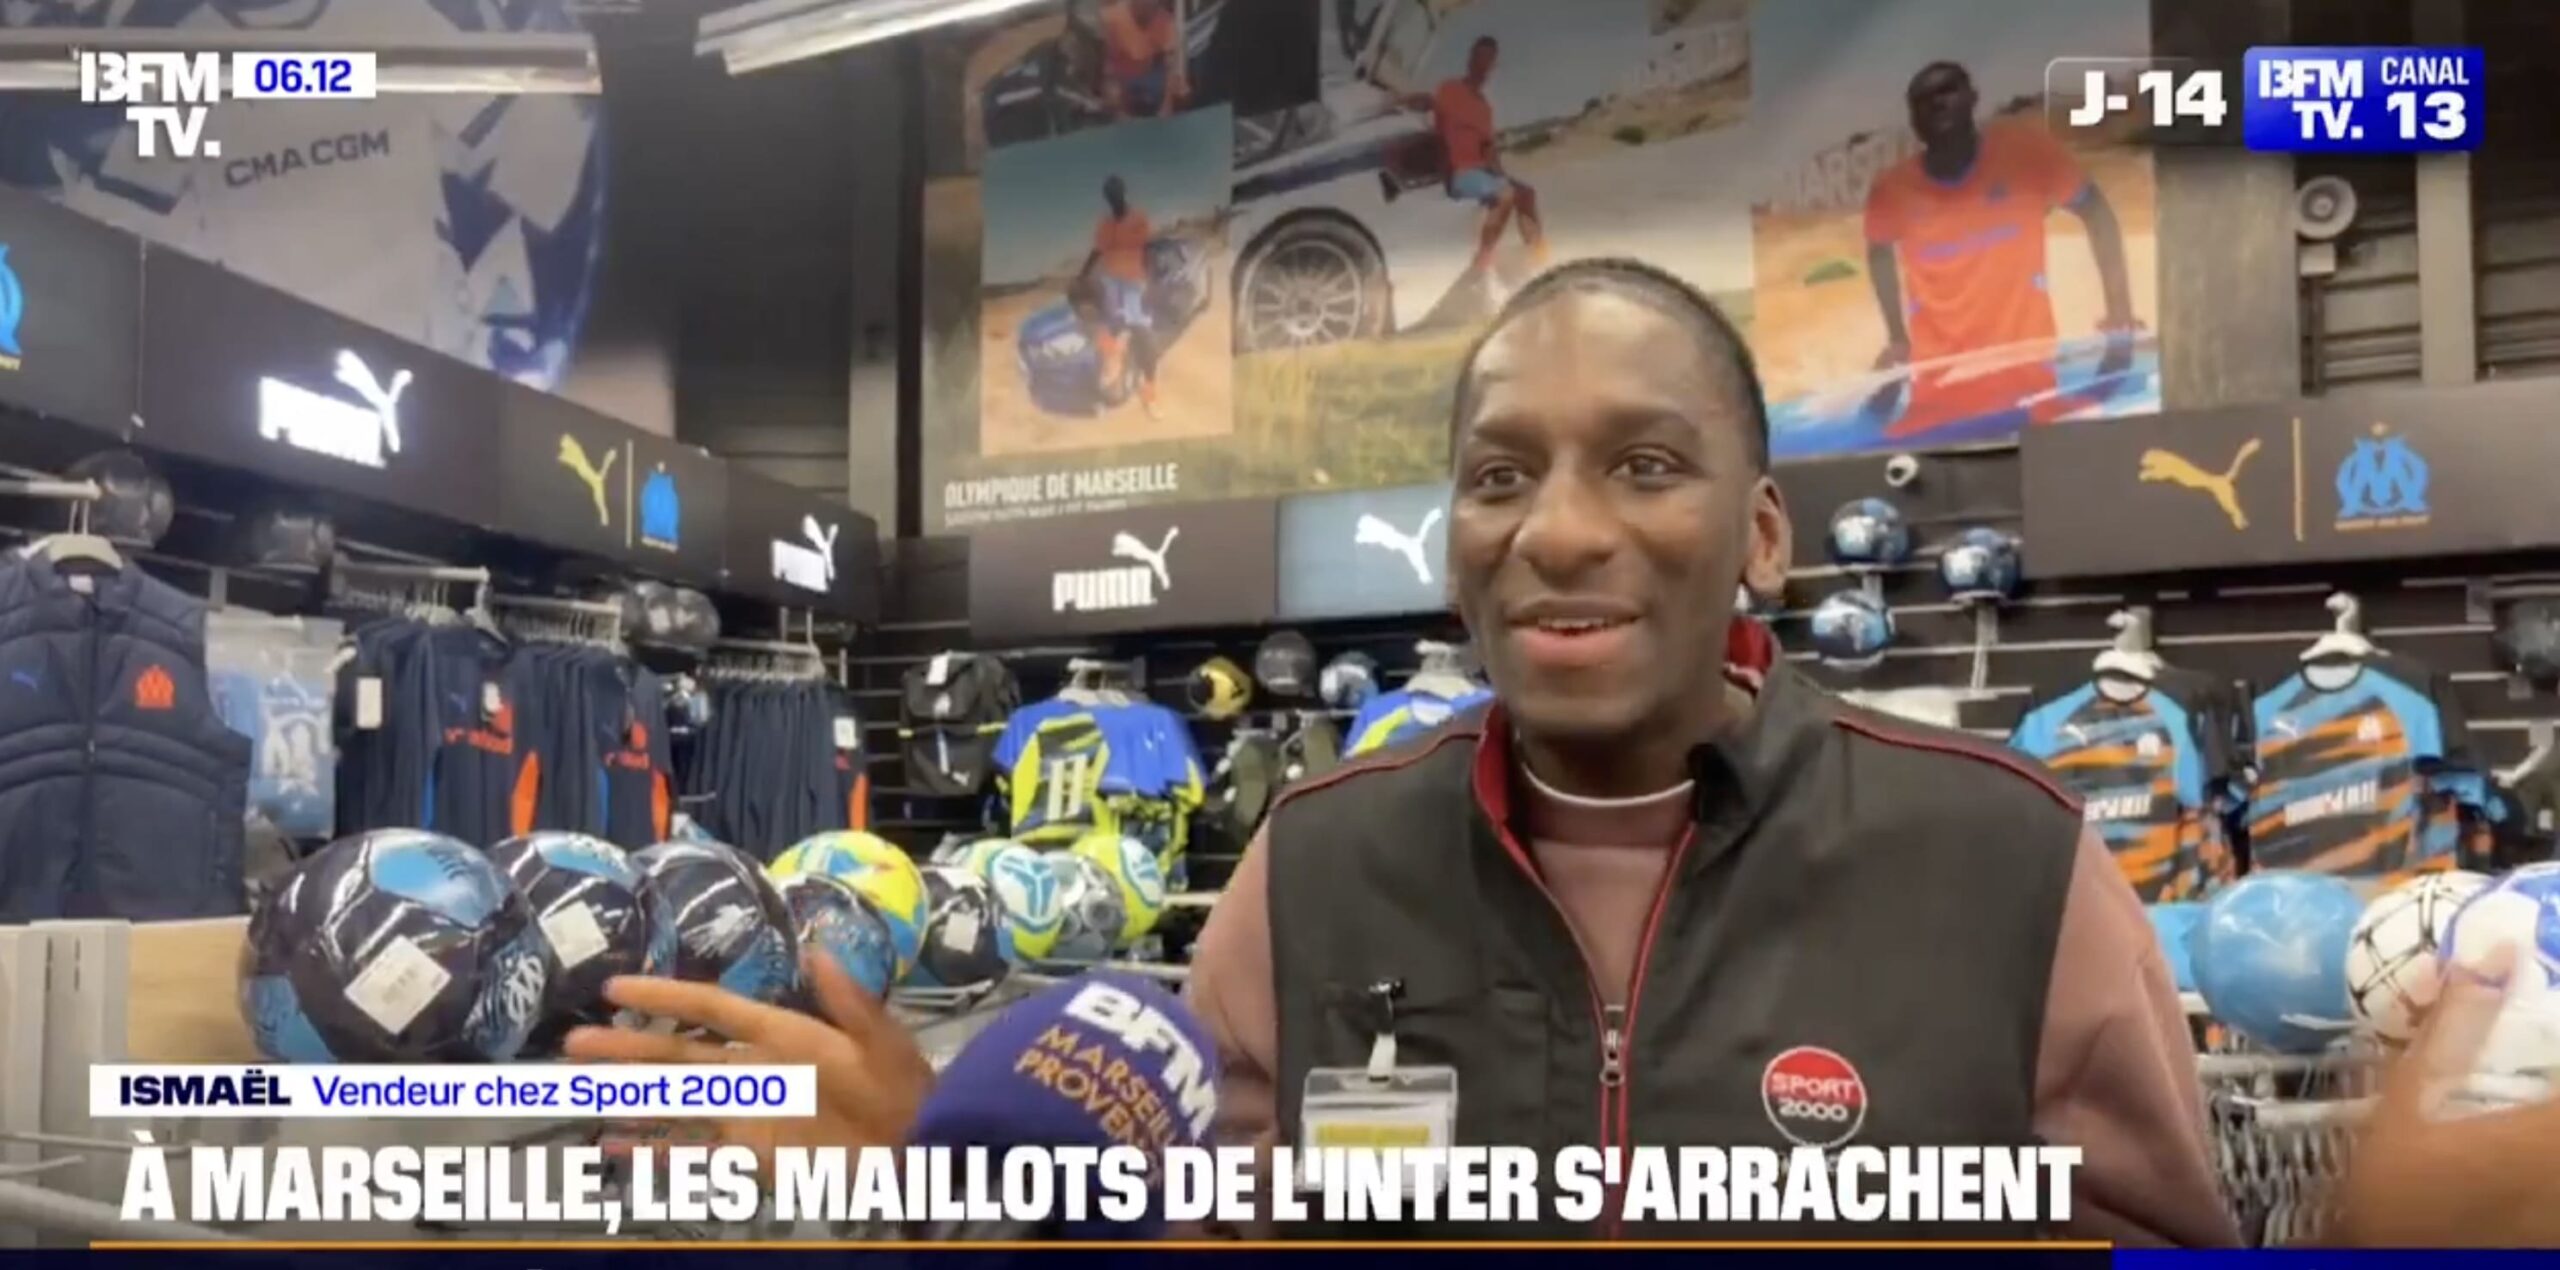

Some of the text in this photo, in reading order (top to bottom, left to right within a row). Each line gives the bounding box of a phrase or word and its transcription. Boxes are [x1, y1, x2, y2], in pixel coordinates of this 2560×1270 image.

[224, 127, 391, 187] CMA CGM
[944, 462, 1179, 510] OLYMPIQUE DE MARSEILLE
[1063, 980, 1217, 1142] BFM
[1770, 1071, 1856, 1101] SPORT
[1777, 1096, 1849, 1122] 2000
